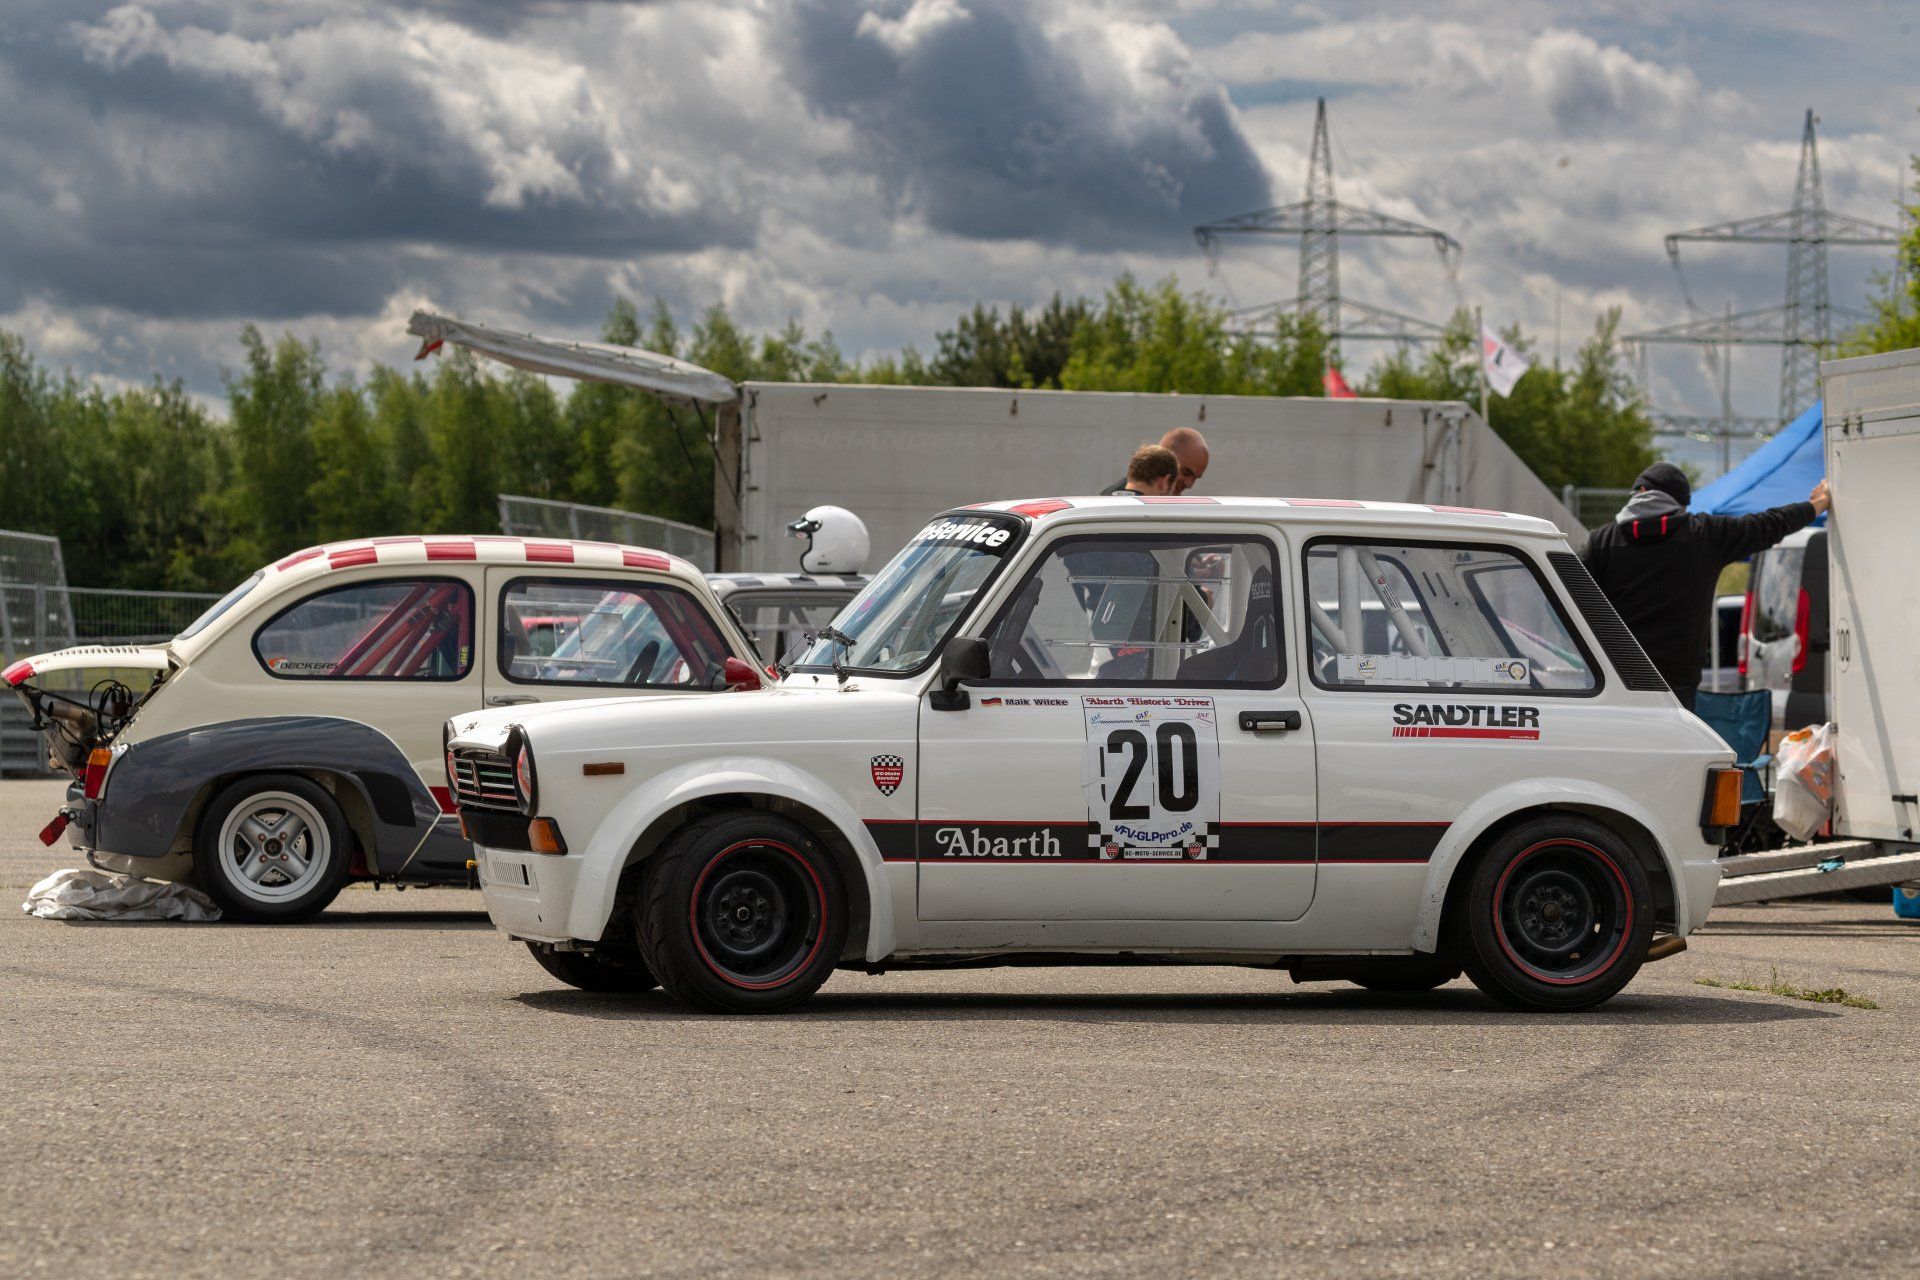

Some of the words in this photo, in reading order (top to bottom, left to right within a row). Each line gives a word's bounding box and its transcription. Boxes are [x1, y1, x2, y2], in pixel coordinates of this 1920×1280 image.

[1005, 698, 1030, 706] Maik
[1033, 698, 1069, 706] Wilcke
[1086, 697, 1125, 706] Abarth
[1127, 697, 1172, 706] Historic
[1174, 698, 1210, 706] Driver
[1393, 703, 1540, 727] SANDTLER
[1107, 722, 1199, 820] 20
[935, 827, 1062, 857] Abarth
